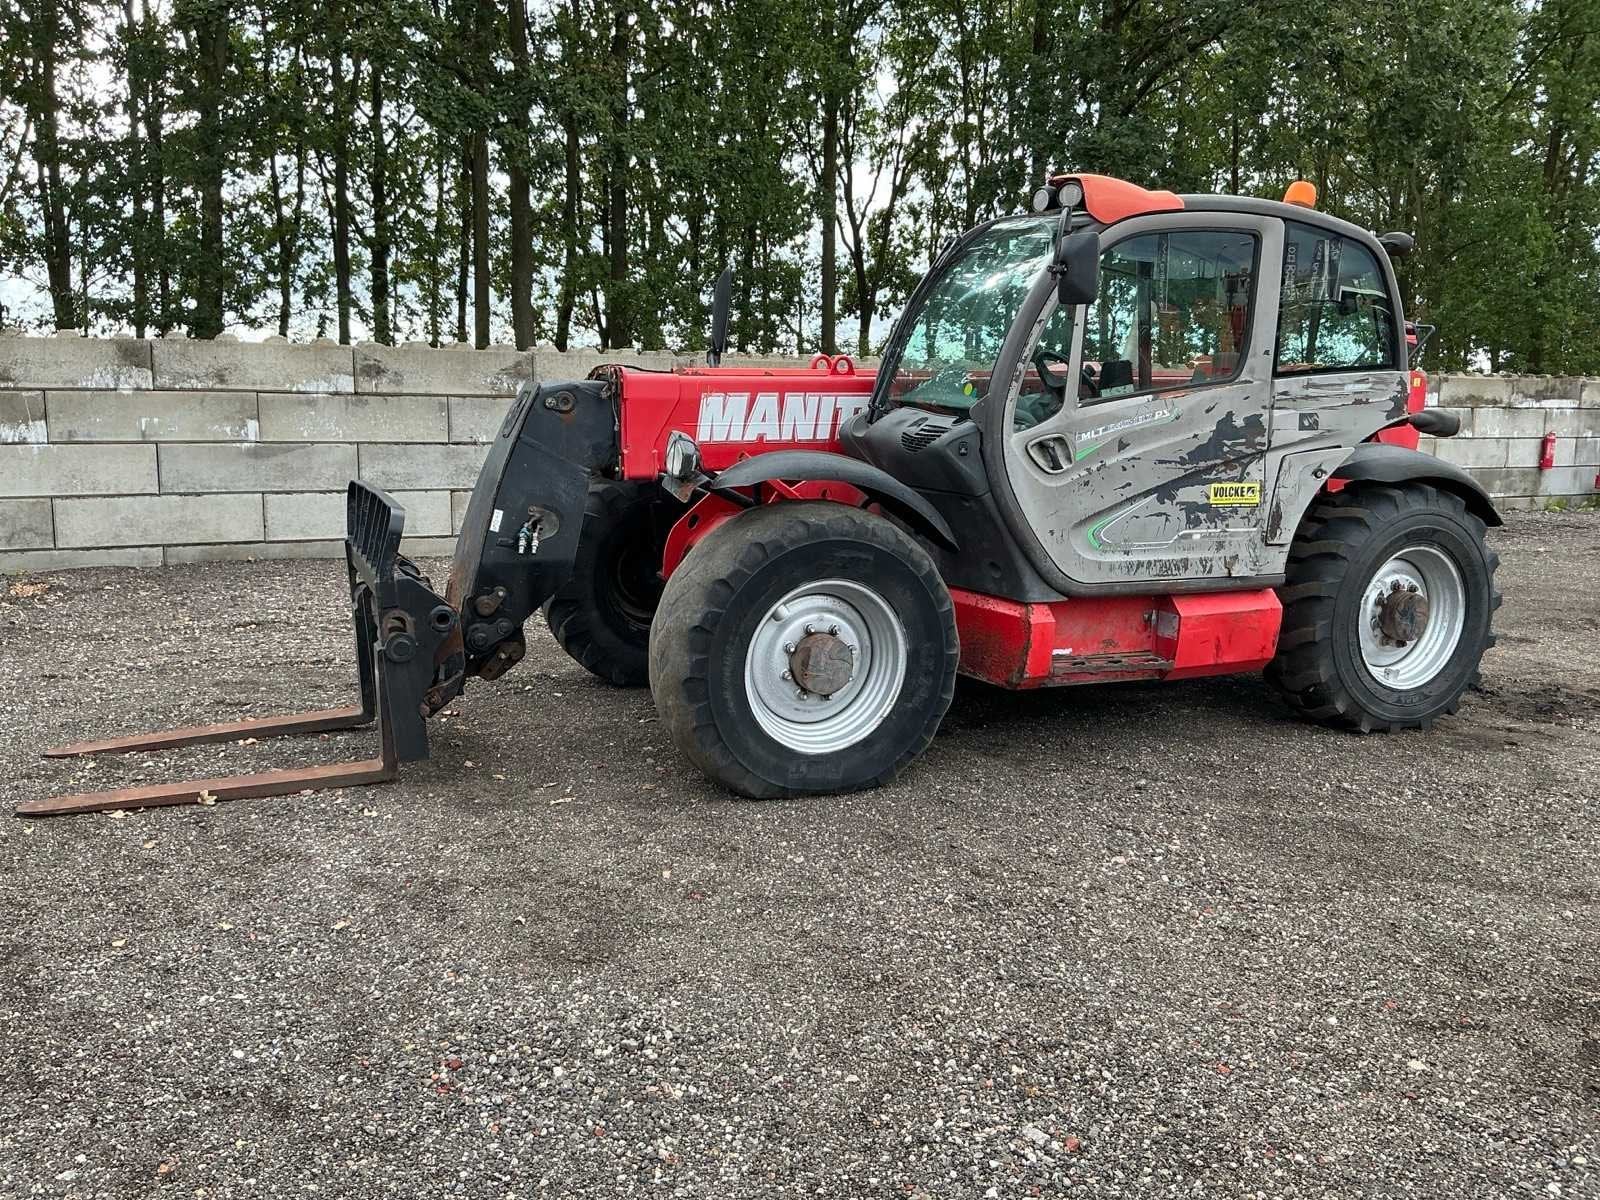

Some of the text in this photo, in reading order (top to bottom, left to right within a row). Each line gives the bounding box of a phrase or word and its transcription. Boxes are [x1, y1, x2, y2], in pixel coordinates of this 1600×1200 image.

[697, 392, 871, 442] MANIT
[1080, 426, 1105, 441] MLT
[1213, 486, 1245, 498] VOLCKE
